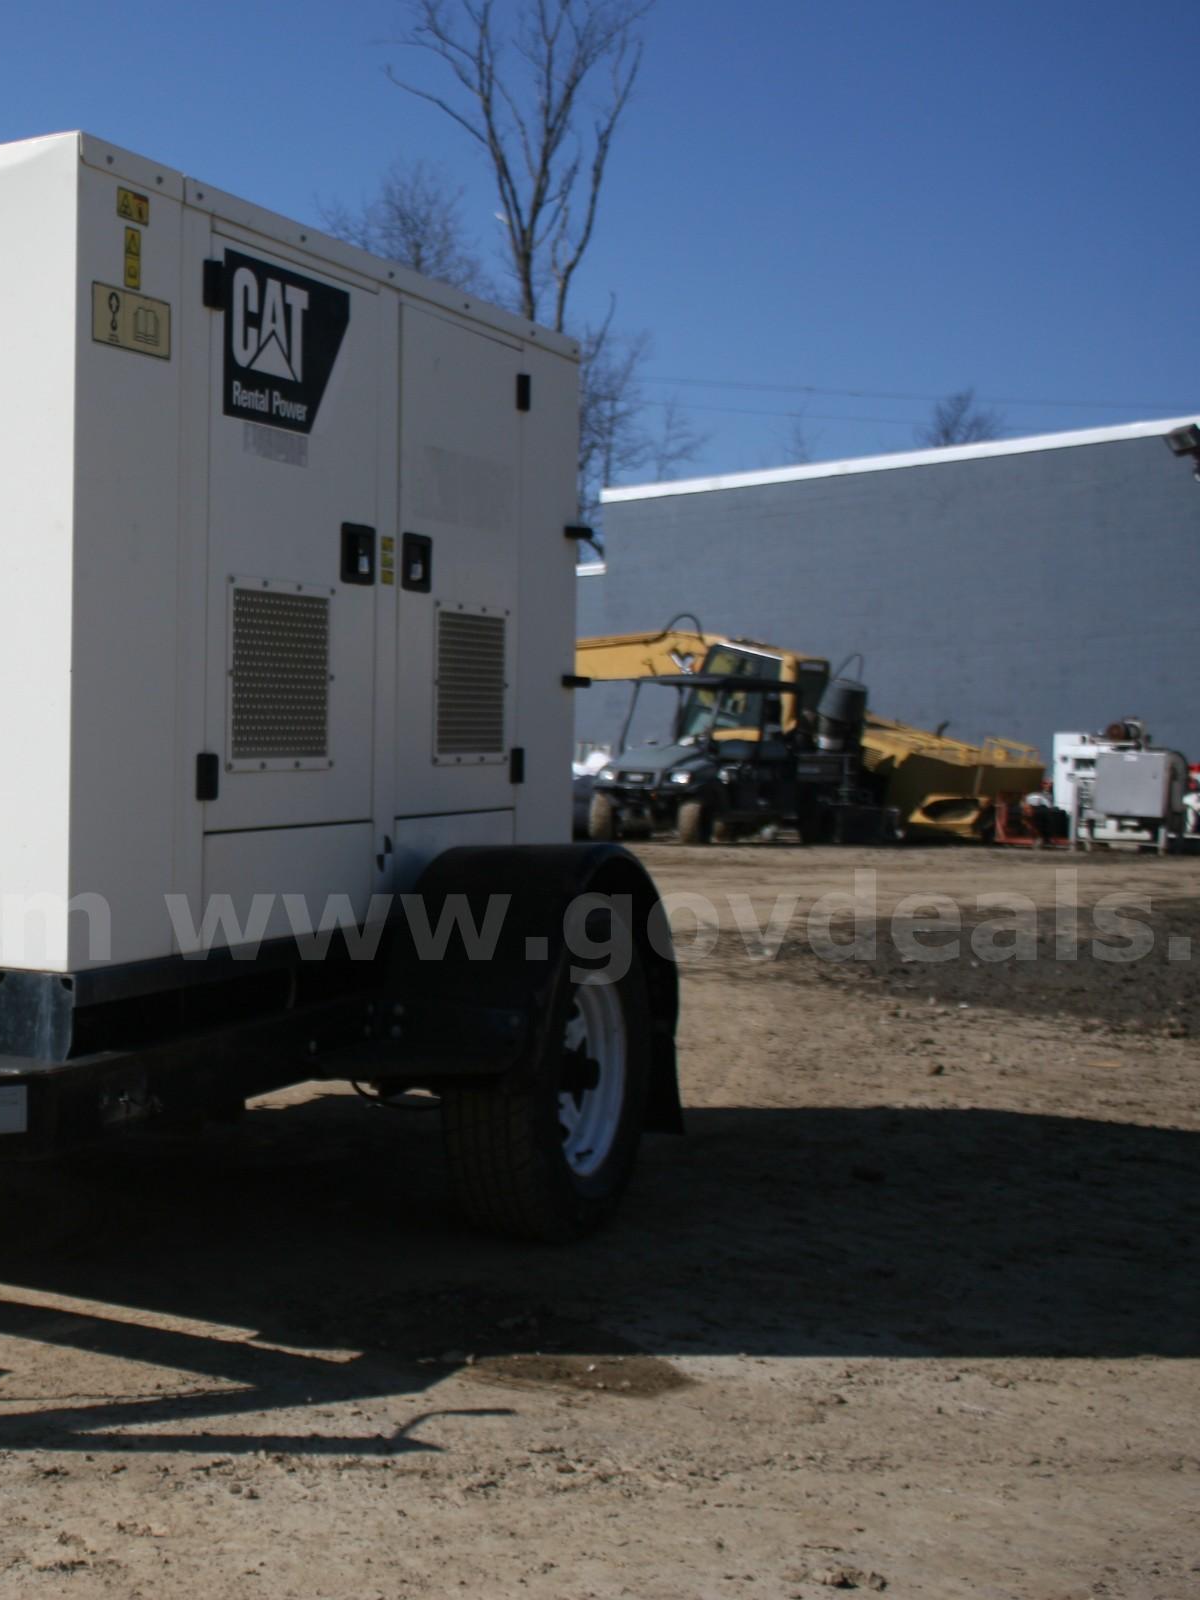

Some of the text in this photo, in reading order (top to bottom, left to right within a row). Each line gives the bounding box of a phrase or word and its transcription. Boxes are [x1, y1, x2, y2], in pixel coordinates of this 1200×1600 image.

[232, 267, 309, 384] CAT
[232, 380, 308, 422] Rental Power
